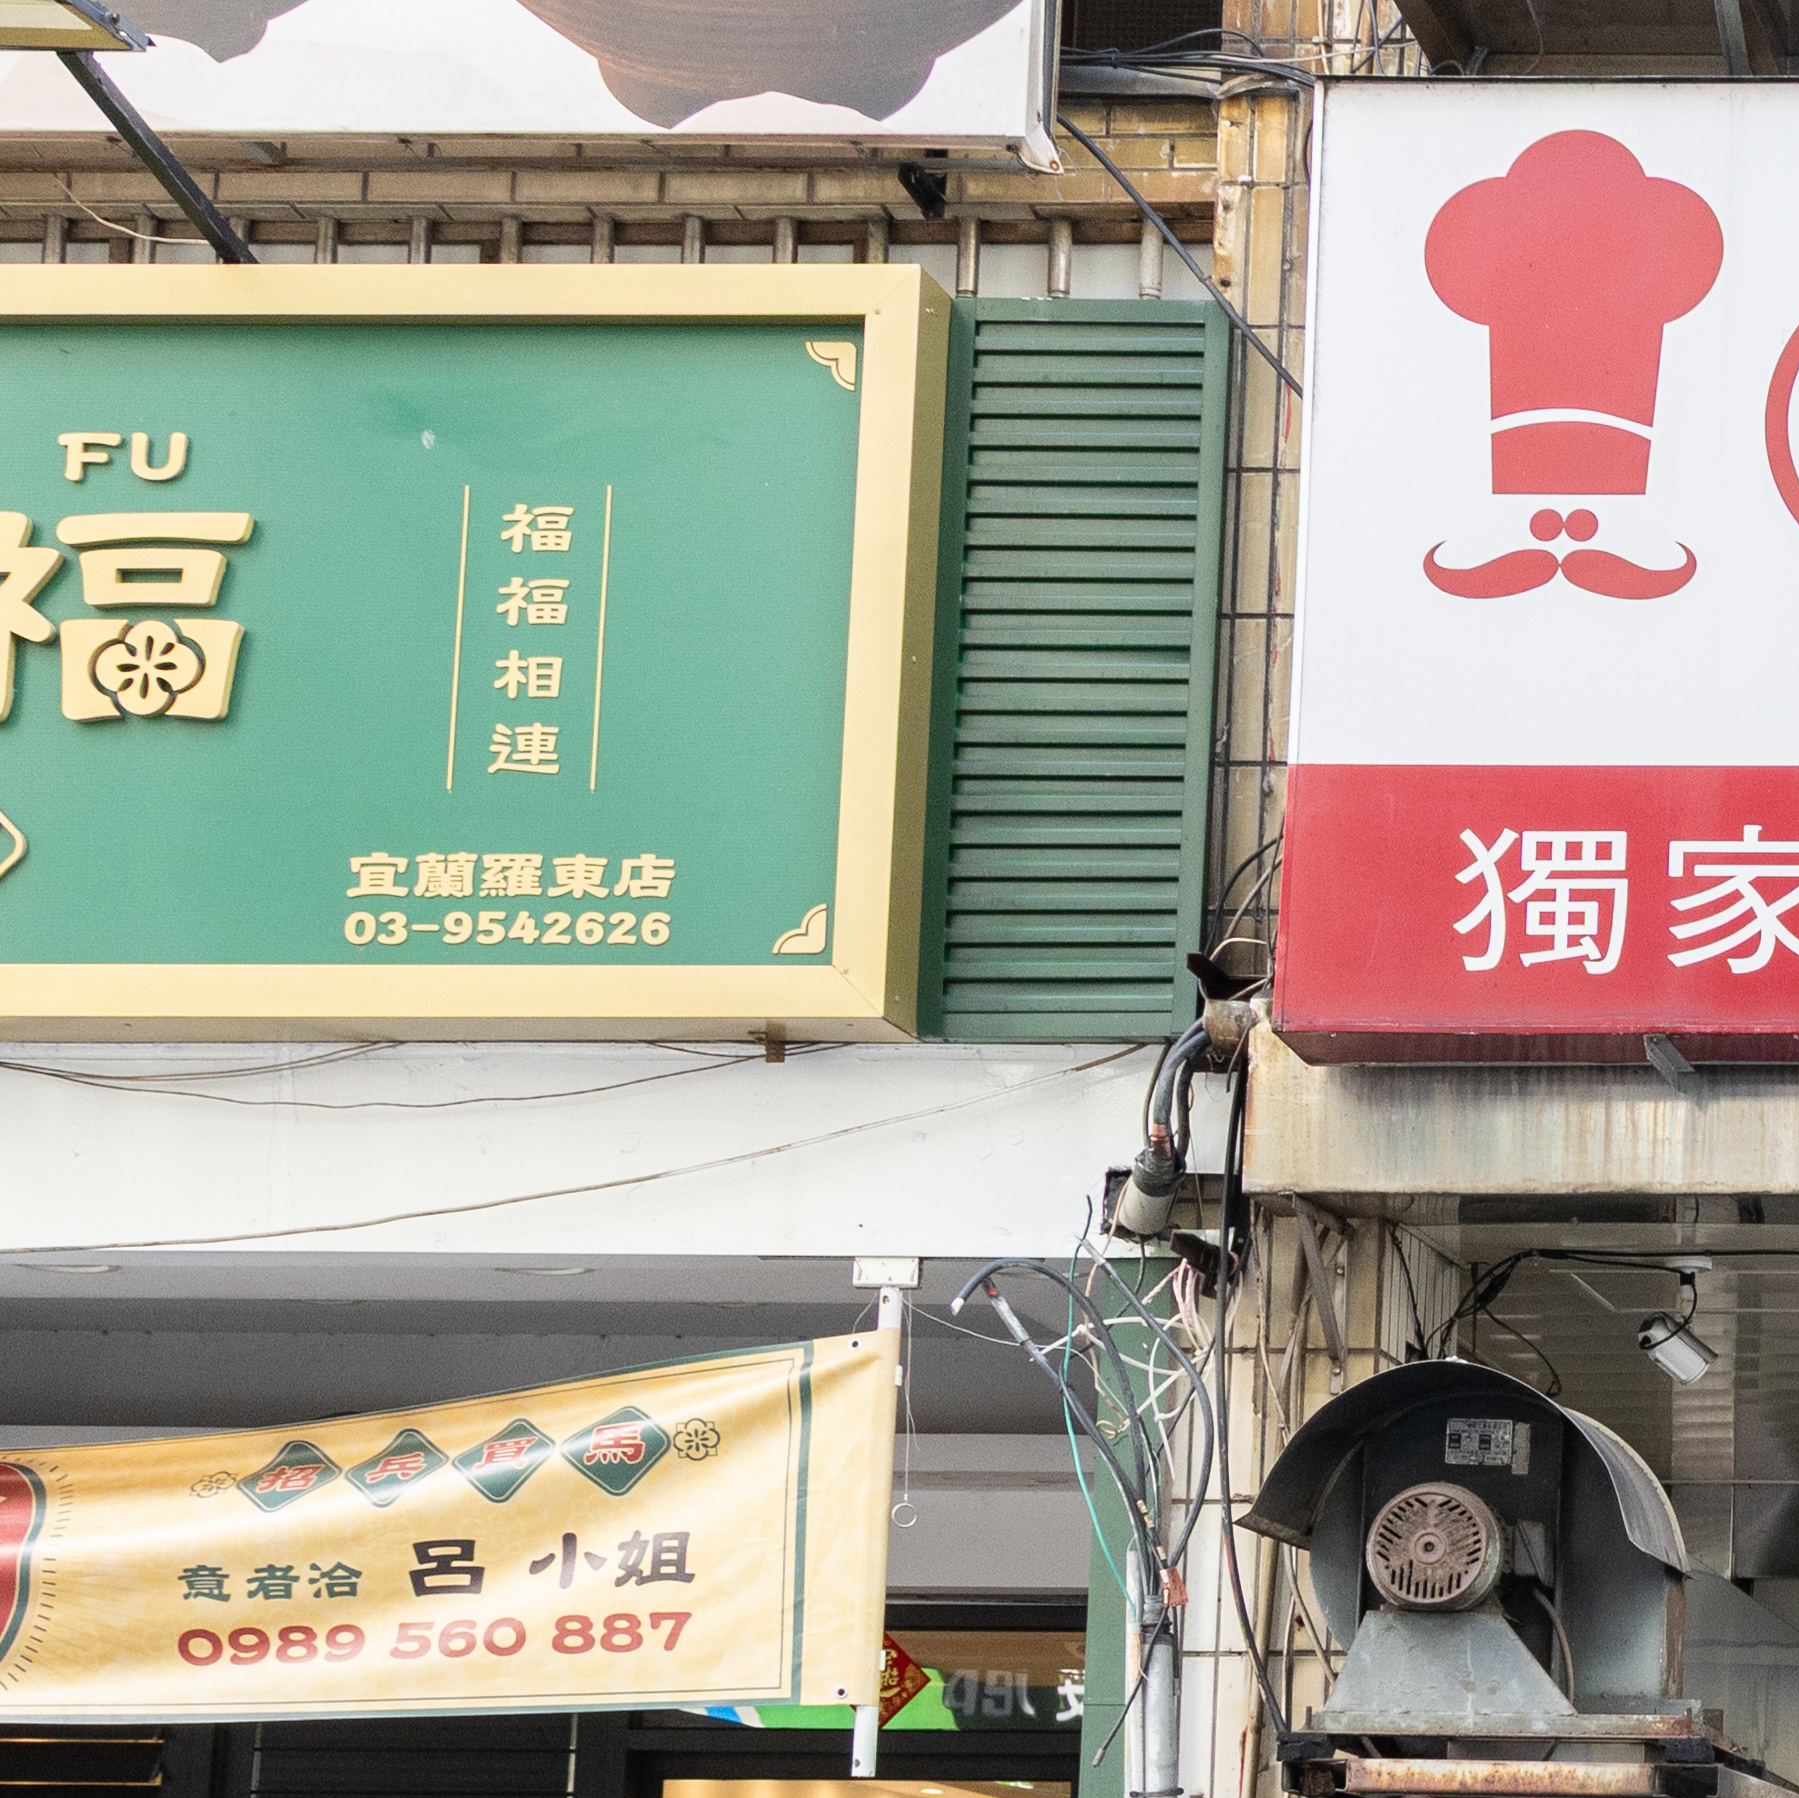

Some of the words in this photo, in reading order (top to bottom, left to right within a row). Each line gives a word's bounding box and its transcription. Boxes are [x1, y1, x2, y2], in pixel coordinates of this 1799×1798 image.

[58, 432, 190, 482] FU
[489, 504, 577, 777] 福福相連
[345, 852, 677, 901] 宜蘭羅東店
[343, 911, 673, 948] 03-9542626
[258, 1422, 646, 1494] 招兵買馬
[178, 1561, 364, 1603] 意者洽
[177, 1624, 366, 1667] 0989
[389, 1617, 528, 1661] 560
[551, 1610, 694, 1655] 887
